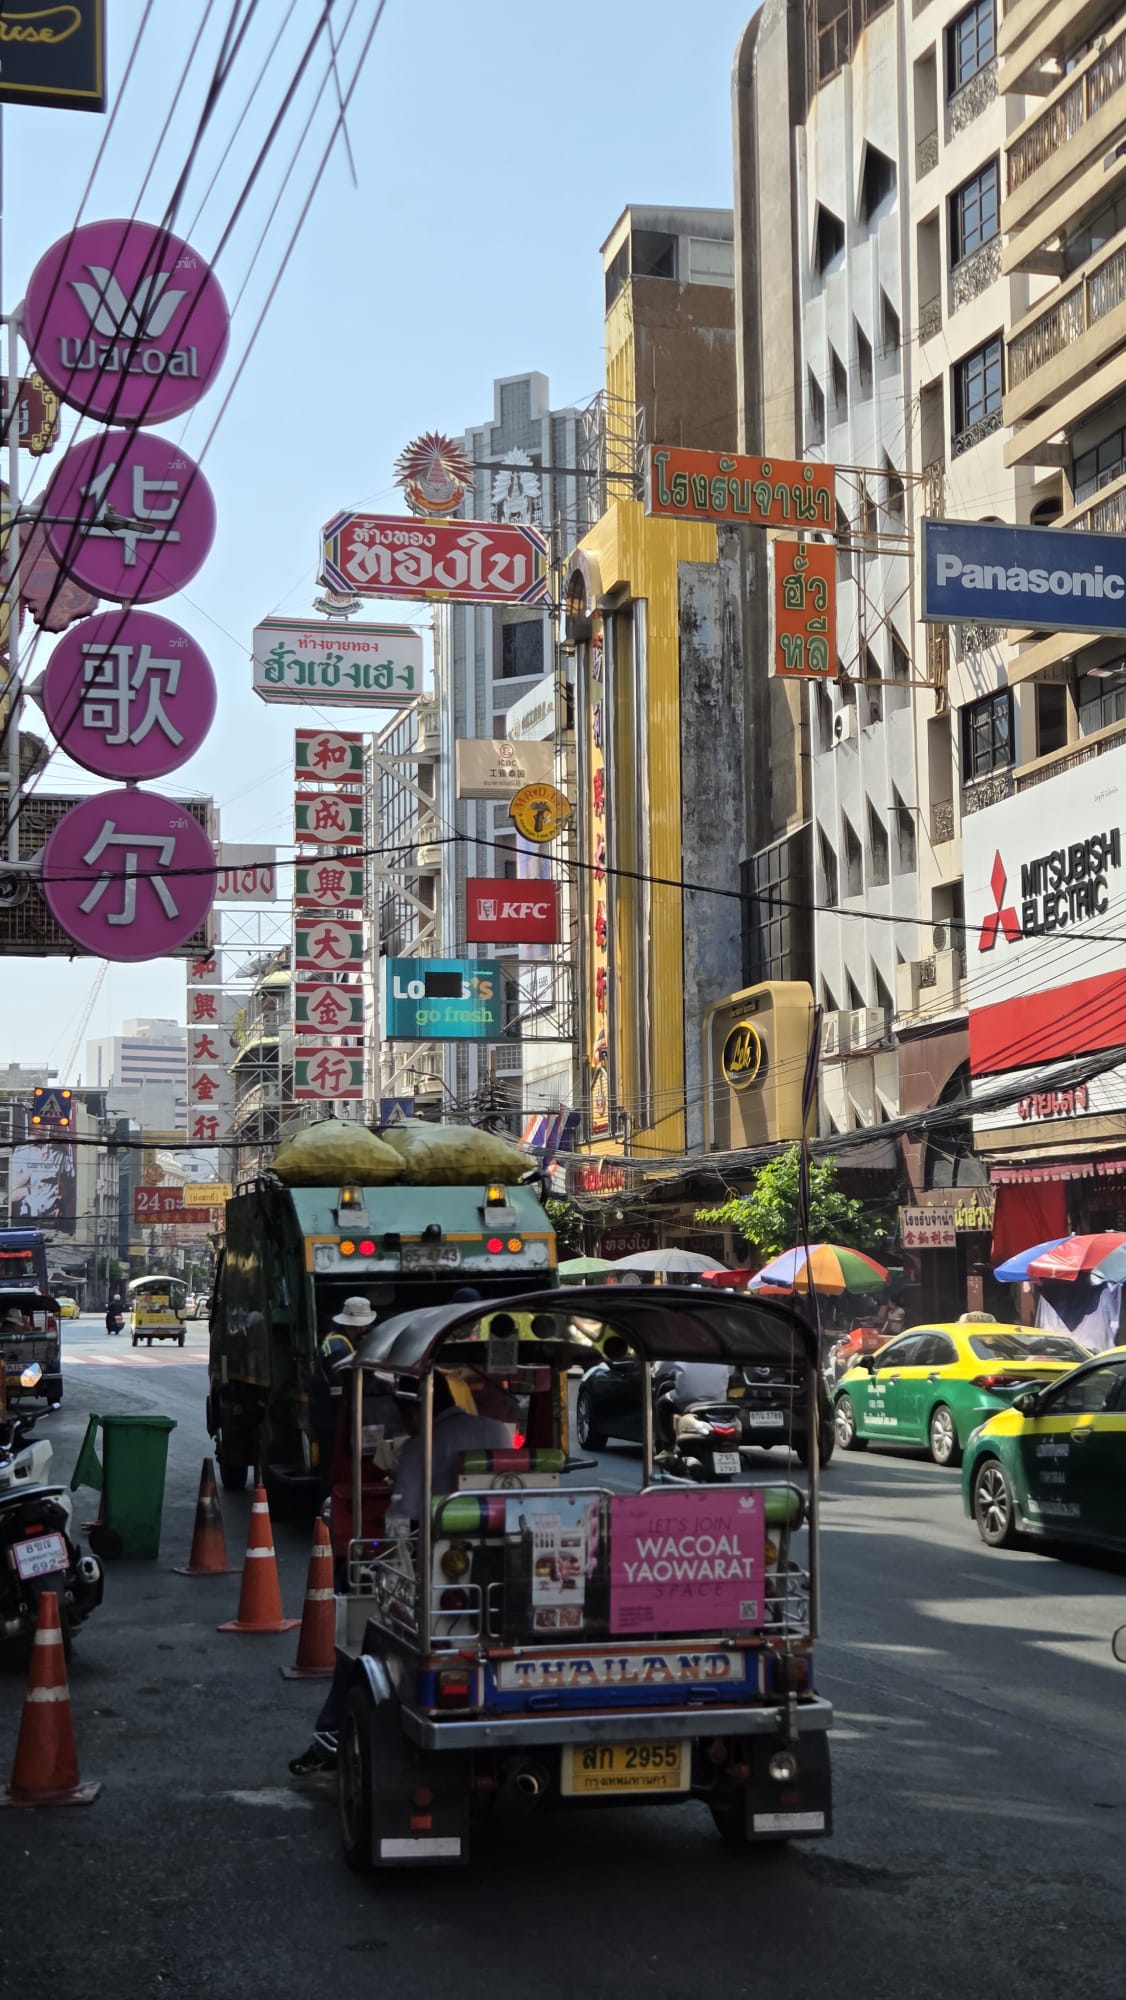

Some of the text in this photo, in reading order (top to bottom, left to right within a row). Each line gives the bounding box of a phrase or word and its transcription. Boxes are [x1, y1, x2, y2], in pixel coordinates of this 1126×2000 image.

[58, 336, 200, 379] Wacoal
[654, 451, 831, 523] โรงรับจำนำ
[352, 523, 436, 547] ห้างทอง
[346, 531, 527, 592] ทองใบ
[936, 553, 1126, 600] Panasonic
[297, 635, 379, 652] ห้างขายทอง
[1021, 827, 1122, 900] MITSUBISHI
[499, 902, 551, 919] KFC
[1022, 874, 1109, 939] ELECTRIC
[393, 976, 494, 1000] Los's
[416, 1006, 494, 1026] go fresh
[138, 1192, 161, 1212] 24
[648, 1517, 732, 1534] LET'S JOIN
[636, 1535, 742, 1559] WACOAL
[623, 1558, 755, 1583] YAOWARAT
[655, 1583, 723, 1599] SPACE
[515, 1653, 732, 1688] THAILAND
[624, 1744, 678, 1769] 2955
